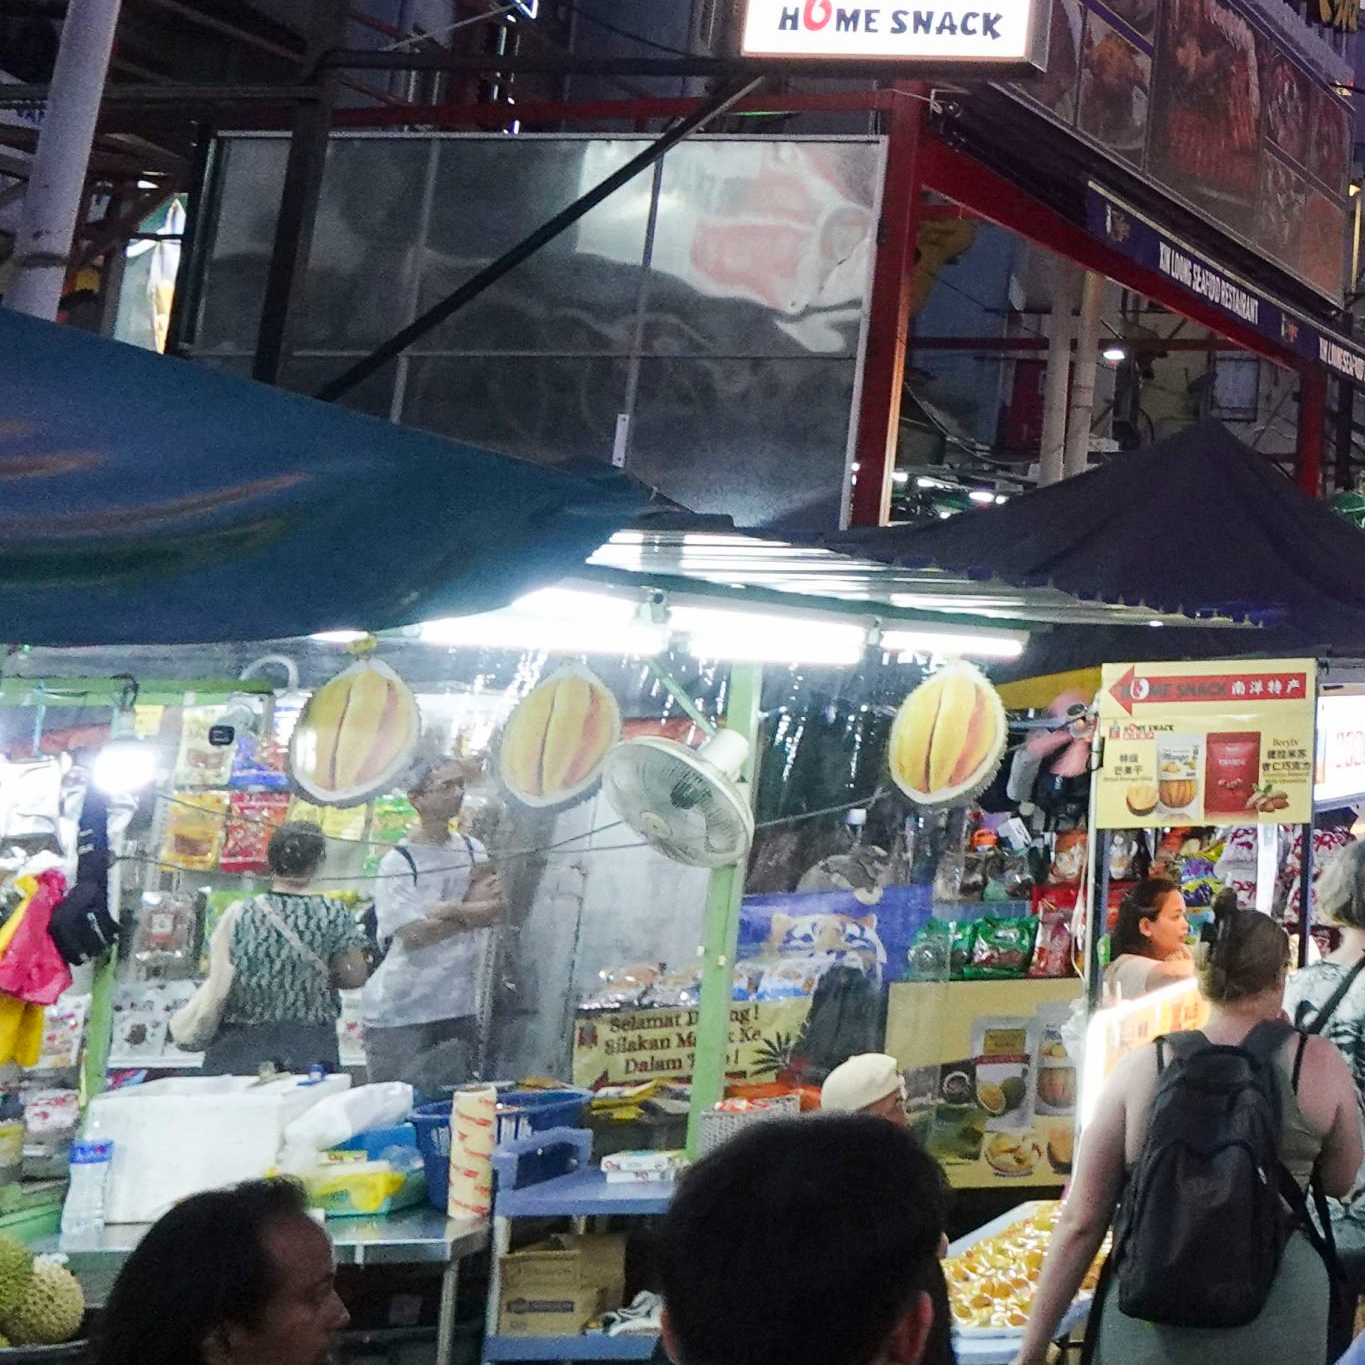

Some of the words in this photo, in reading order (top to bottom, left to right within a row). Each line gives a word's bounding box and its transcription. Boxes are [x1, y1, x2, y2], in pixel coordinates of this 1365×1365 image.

[890, 8, 1003, 41] SNACK
[608, 1012, 681, 1034] Selamat
[603, 1035, 672, 1056] Silakan
[623, 1058, 684, 1074] Dalam
